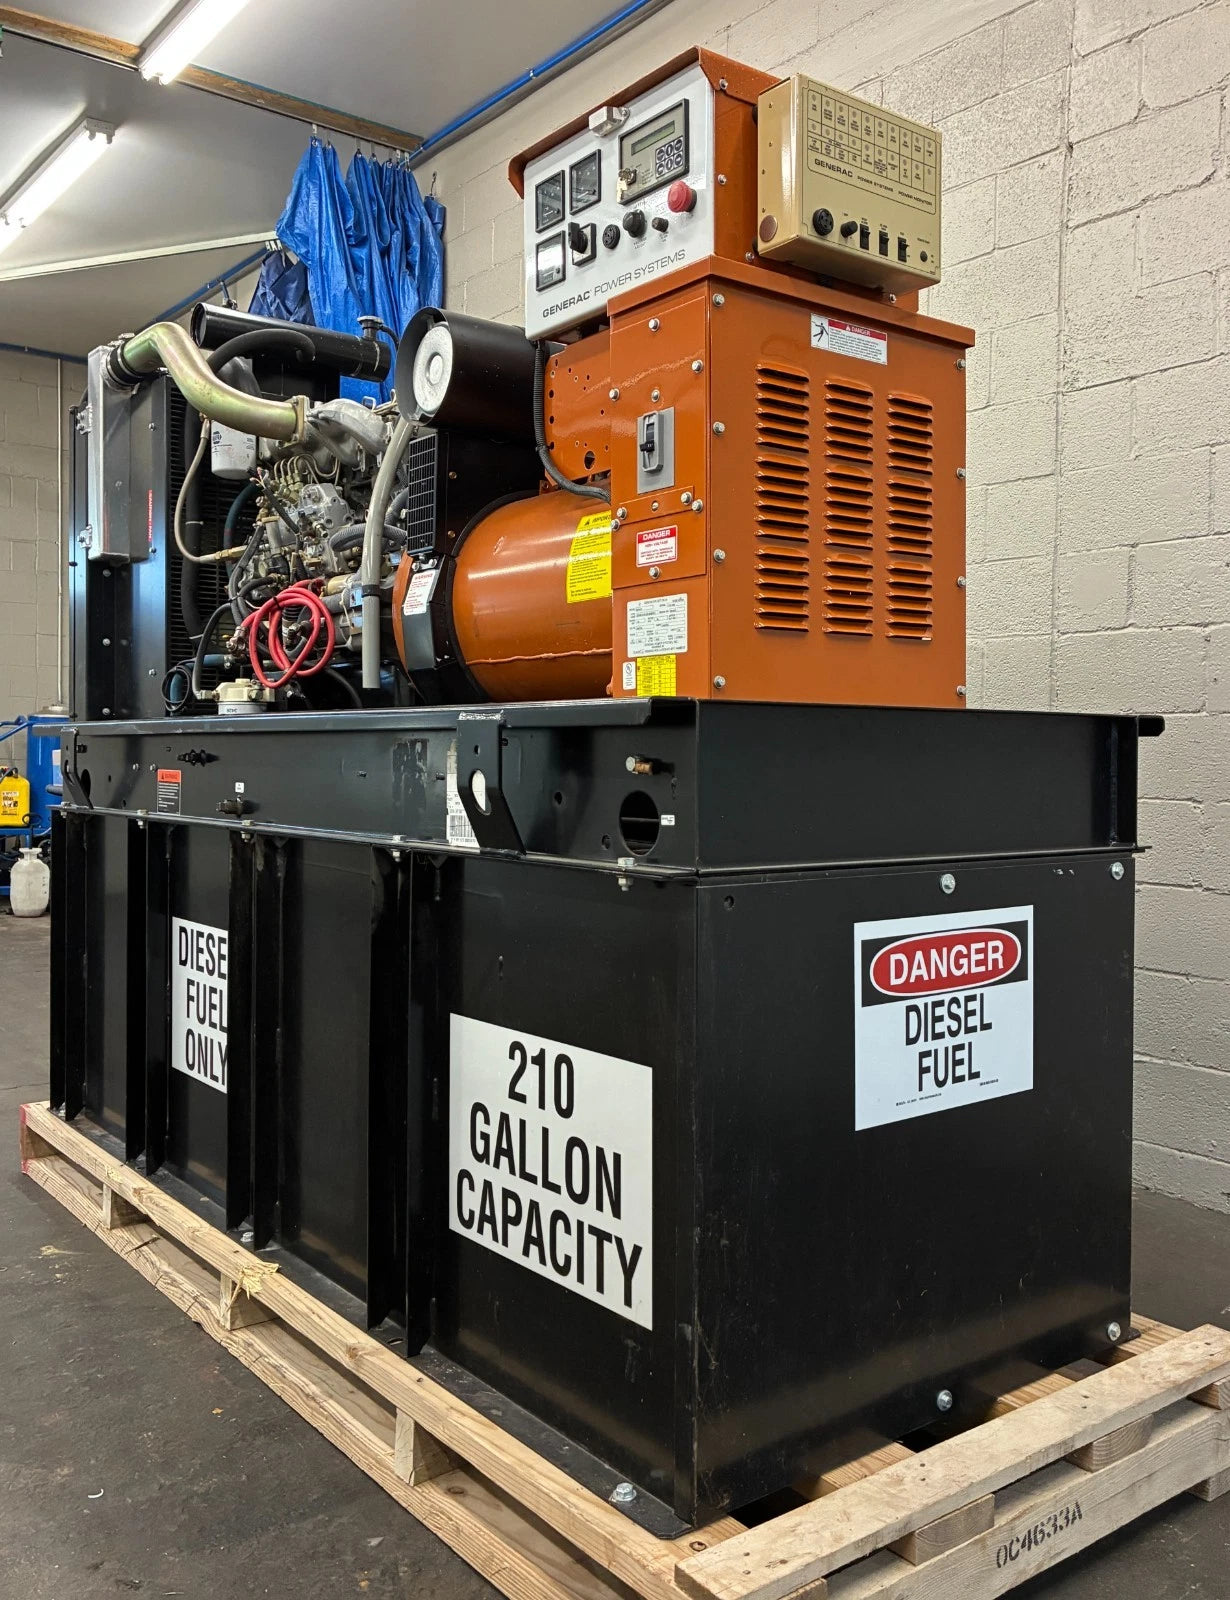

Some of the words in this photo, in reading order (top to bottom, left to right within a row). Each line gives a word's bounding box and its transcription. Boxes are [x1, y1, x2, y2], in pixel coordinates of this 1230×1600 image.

[814, 158, 853, 178] GENERAC
[542, 290, 591, 318] GENERAC
[594, 272, 632, 296] POWER
[634, 249, 686, 280] SYSTEMS
[851, 326, 871, 336] DANGER
[642, 529, 671, 541] DANGER
[178, 925, 227, 980] DIESE
[889, 939, 1005, 986] DANGER
[186, 977, 228, 1034] FUEL
[905, 992, 993, 1047] DIESEL
[185, 1028, 228, 1086] ONLY
[508, 1040, 575, 1119] 210
[918, 1041, 981, 1092] FUEL
[469, 1101, 622, 1220] GALLON
[456, 1168, 643, 1310] CAPACITY
